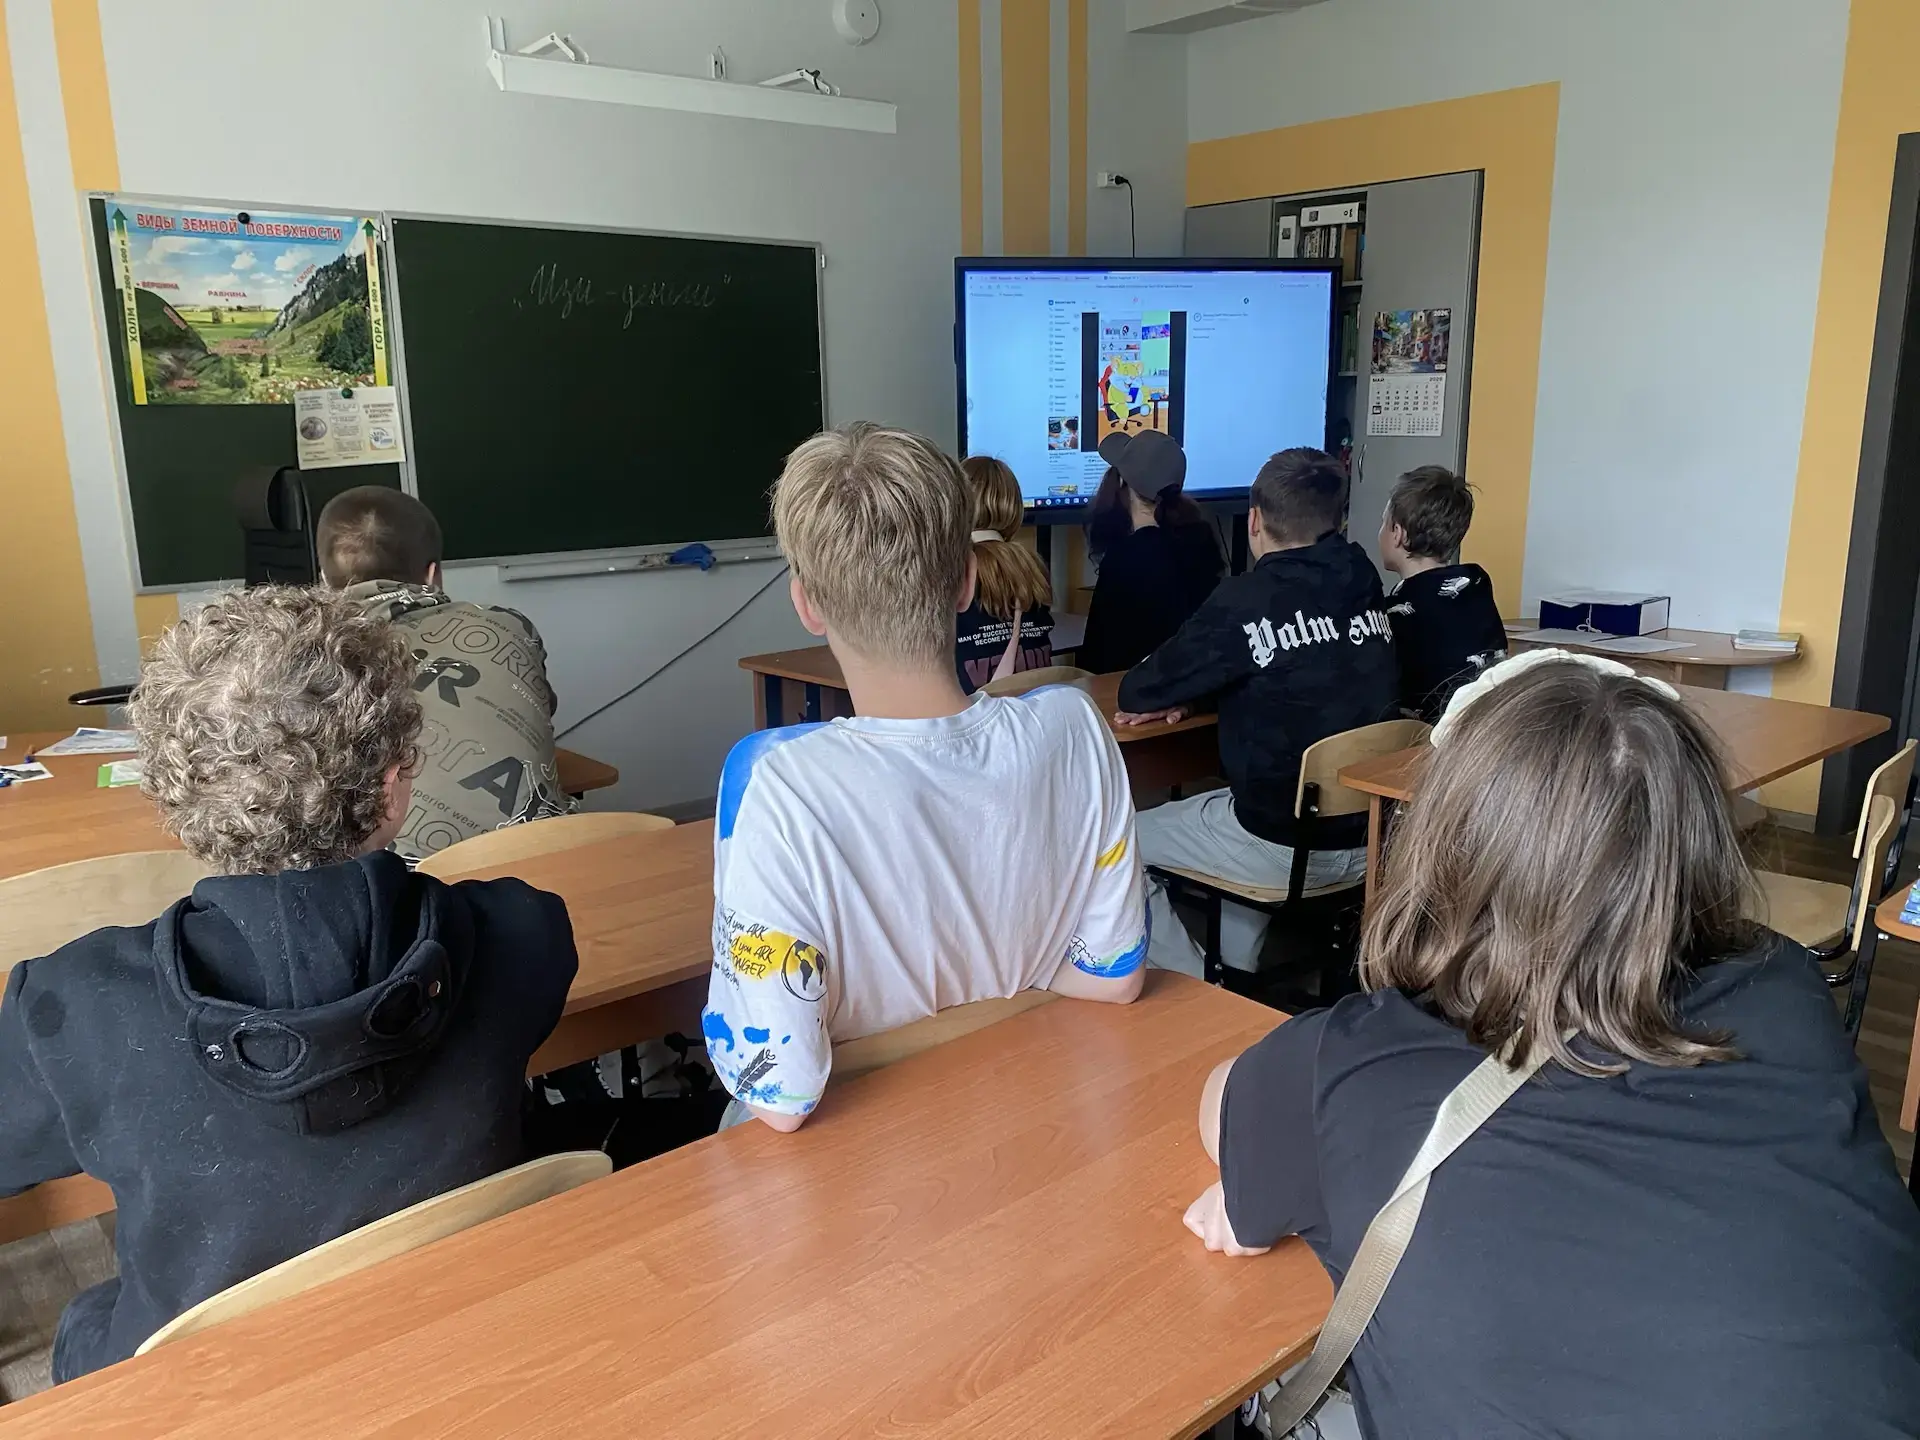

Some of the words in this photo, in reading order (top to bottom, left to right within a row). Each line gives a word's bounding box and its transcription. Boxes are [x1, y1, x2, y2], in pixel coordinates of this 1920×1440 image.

[136, 212, 176, 232] ВИДЫ
[181, 216, 239, 235] ЗЕМНОЙ
[246, 222, 343, 242] ПОВЕРХНОСТИ
[208, 290, 248, 298] РАВНИНА
[126, 308, 138, 343] ХОЛМ
[374, 318, 384, 350] ГОРА
[974, 636, 1001, 646] BECOME
[982, 630, 1009, 638] SUCCESS
[1243, 610, 1340, 668] Palm
[452, 810, 480, 830] wear
